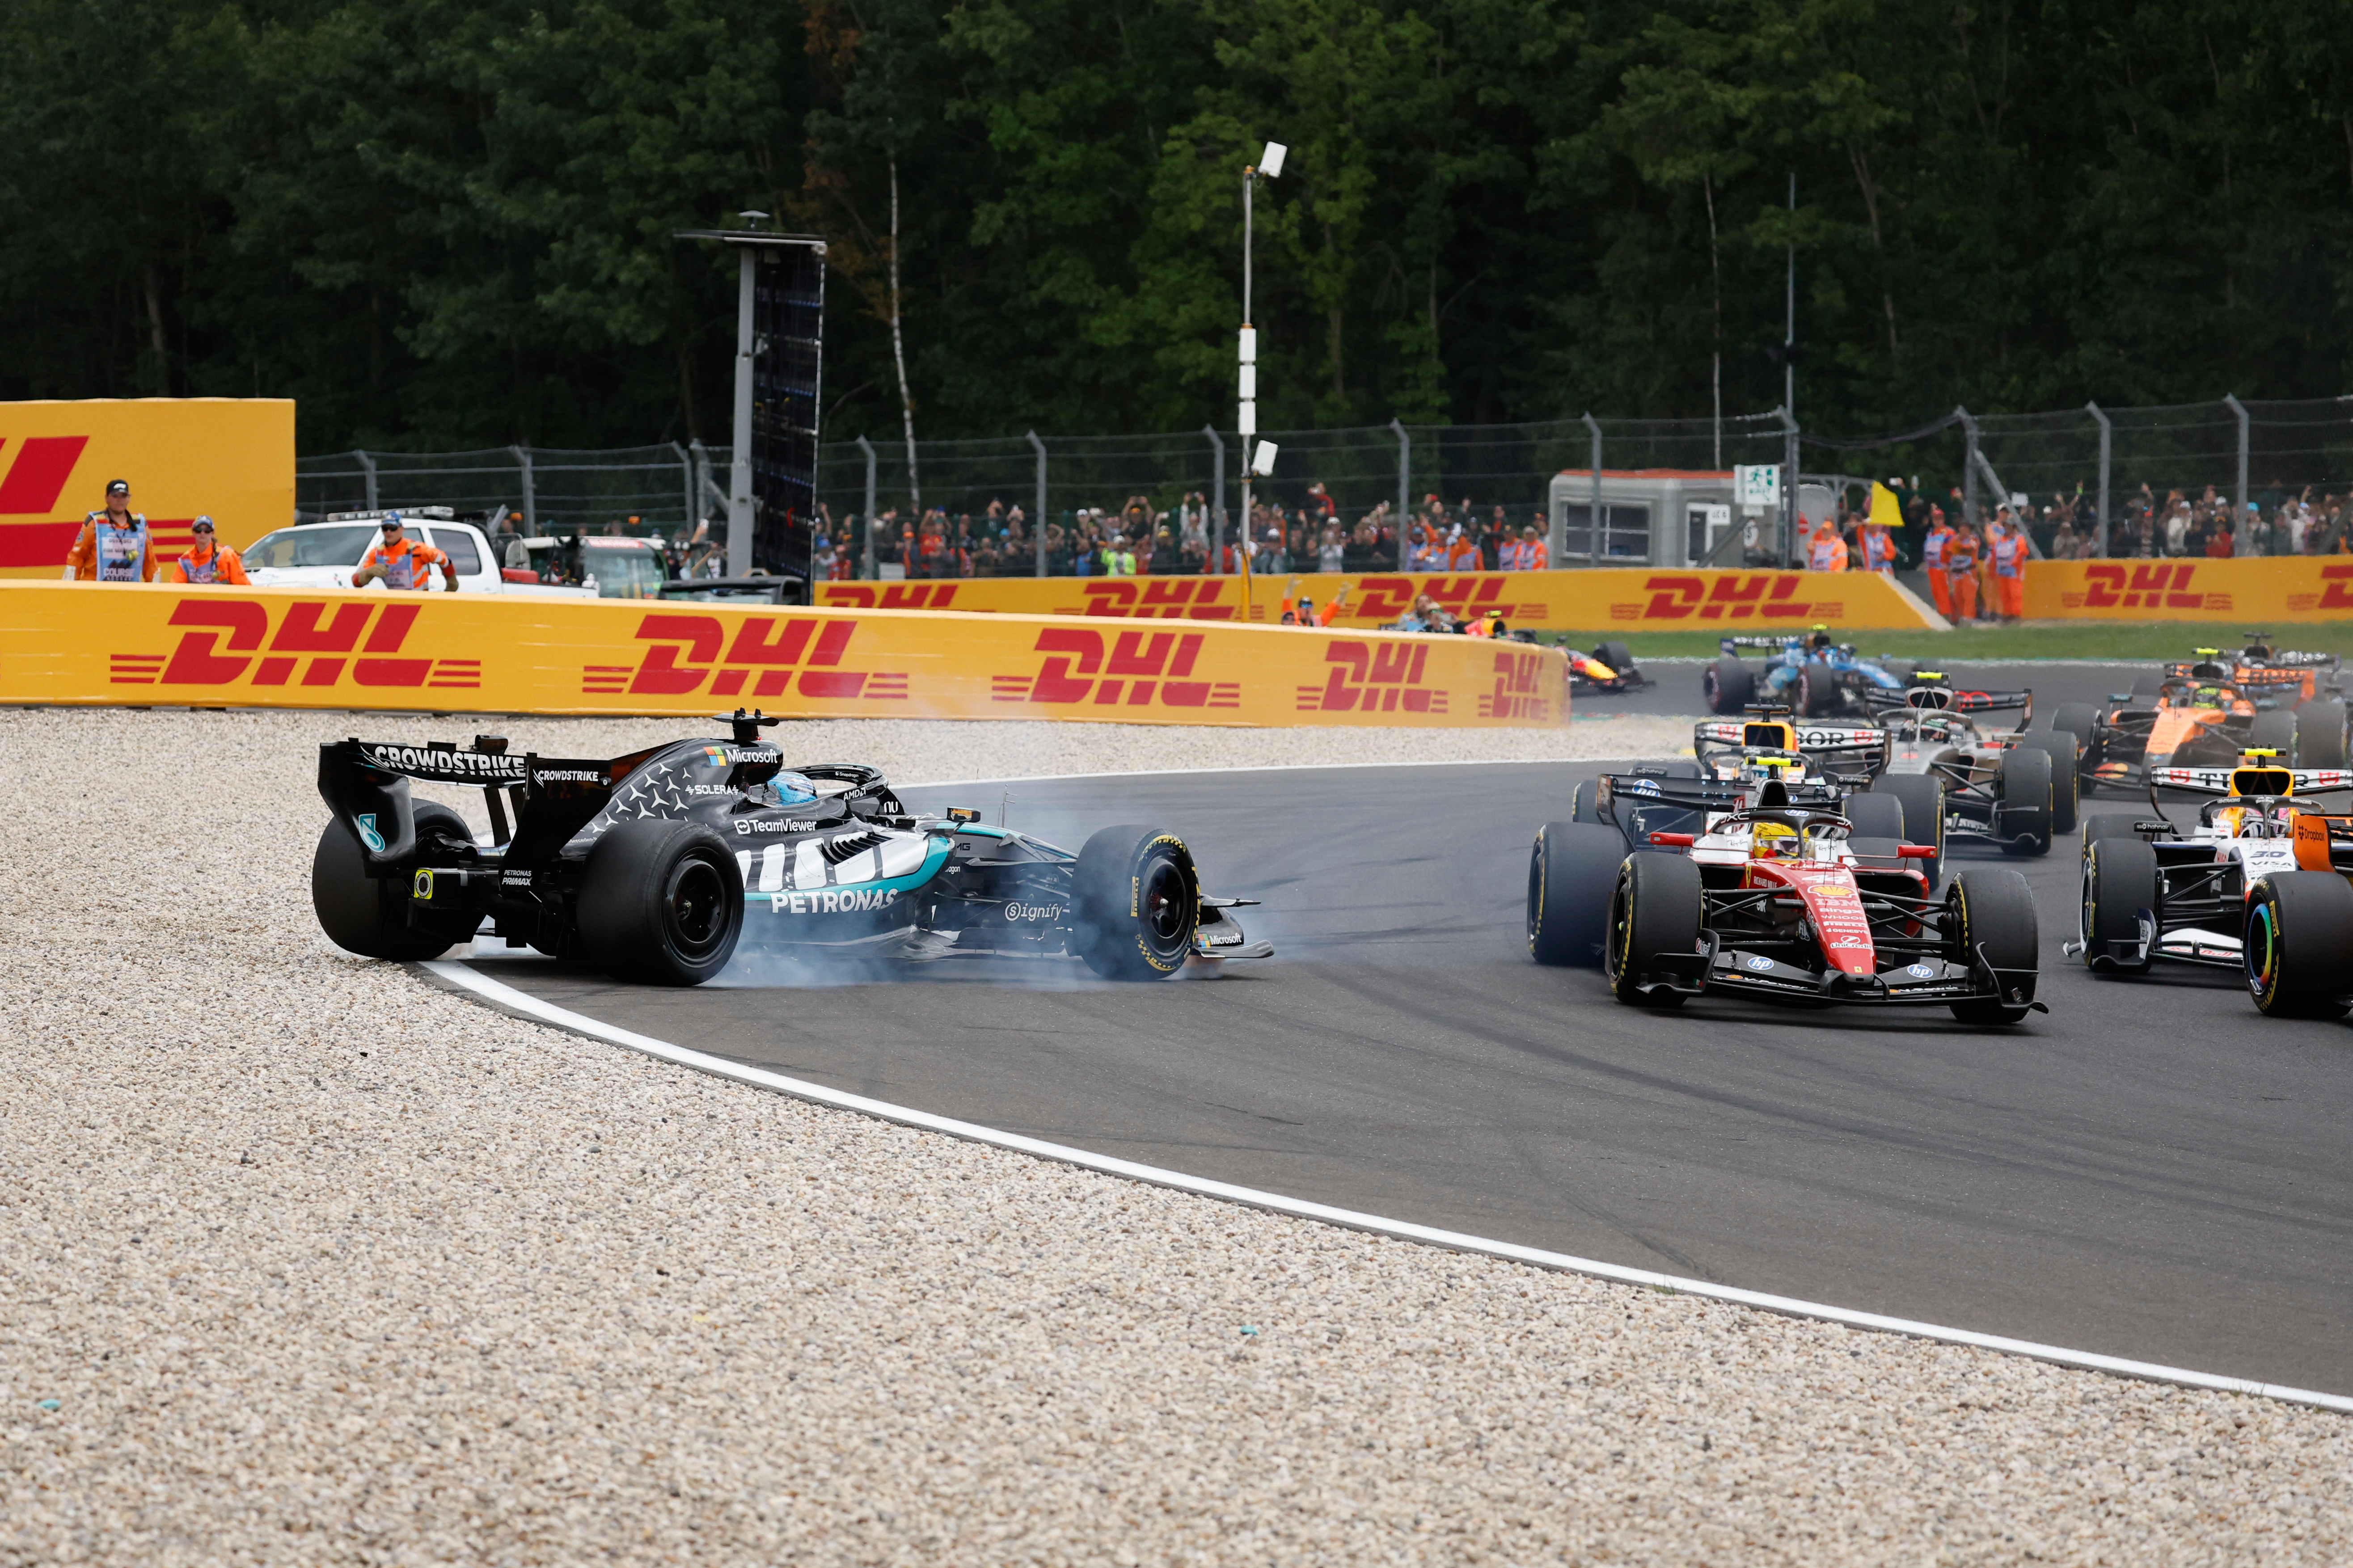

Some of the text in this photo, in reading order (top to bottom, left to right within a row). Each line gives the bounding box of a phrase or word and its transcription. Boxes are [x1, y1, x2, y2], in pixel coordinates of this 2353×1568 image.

[2084, 565, 2204, 607] DHL
[821, 585, 959, 609] DHL
[1084, 581, 1235, 620] DHL
[1356, 577, 1515, 618] DHL
[1644, 576, 1812, 619] DHL
[160, 599, 434, 687] DHL
[629, 615, 868, 698] DHL
[1030, 628, 1212, 707] DHL
[1321, 641, 1432, 712] DHL
[1492, 651, 1544, 721] DHL
[375, 746, 526, 777] CROWDSTRIKE
[726, 748, 778, 764] Microsoft
[538, 770, 599, 782] CROWDSTRIKE
[694, 785, 731, 795] SOLERA
[843, 789, 860, 801] AMD
[749, 818, 817, 832] TeamViewer
[2304, 828, 2325, 843] Dropbox
[502, 877, 533, 886] PRIMAX
[1753, 876, 1767, 888] RICHARD
[1802, 874, 1849, 884] 44
[769, 888, 899, 914] PETRONAS
[1815, 898, 1861, 907] IBM
[1210, 932, 1242, 945] Microsoft
[1752, 957, 1770, 970] hp
[1912, 965, 1930, 978] hp
[1744, 977, 1808, 989] V-Power
